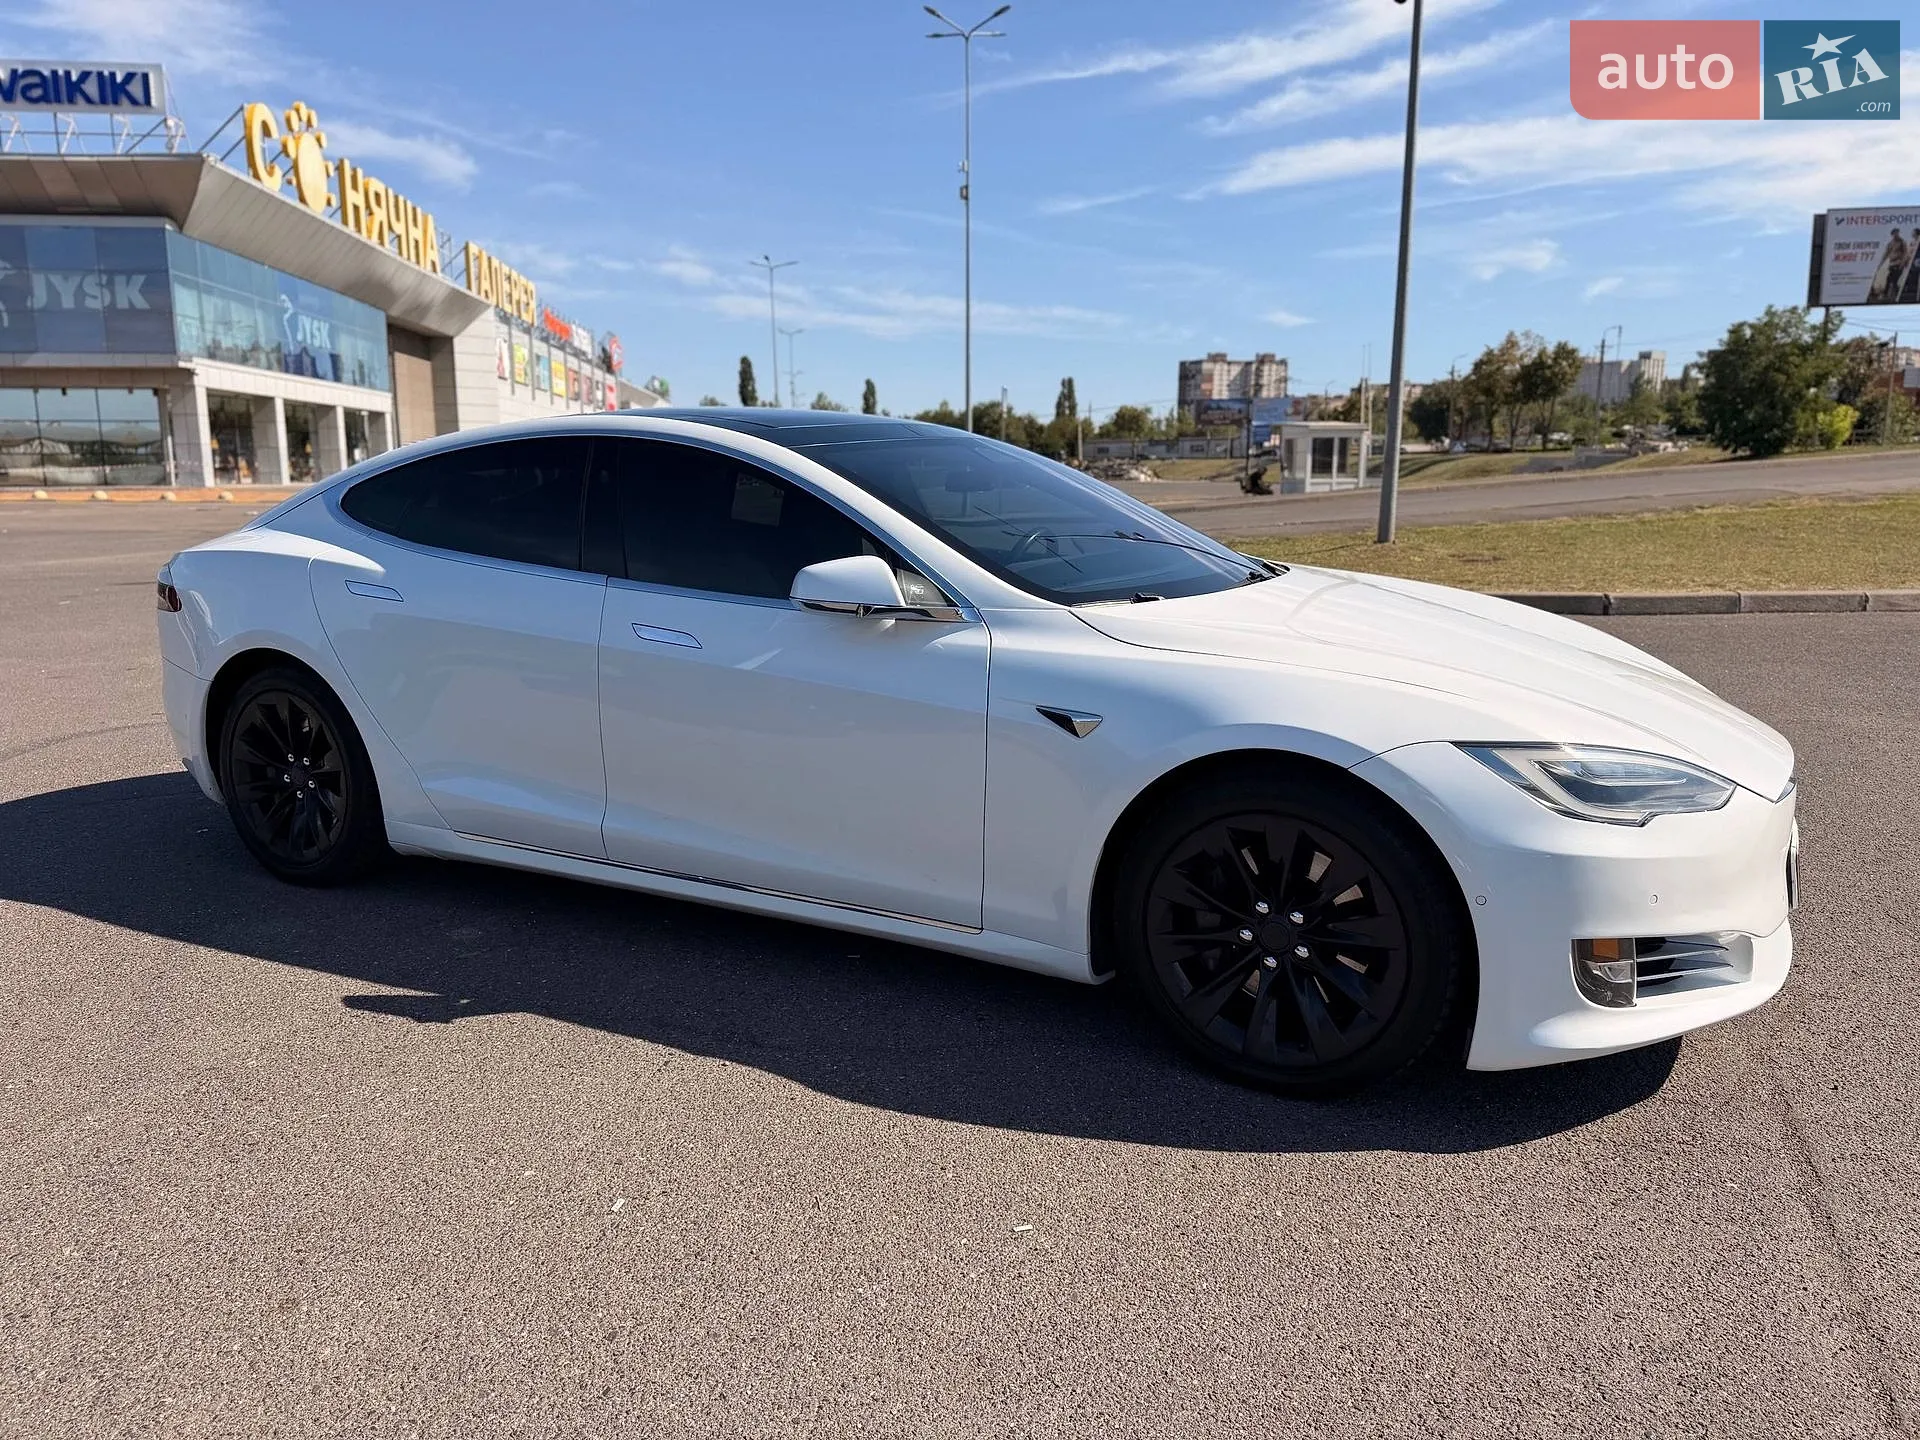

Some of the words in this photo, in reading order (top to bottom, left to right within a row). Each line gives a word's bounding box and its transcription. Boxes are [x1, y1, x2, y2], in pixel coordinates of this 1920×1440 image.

[1846, 214, 1920, 225] INTERSPORT
[28, 274, 151, 310] JYSK
[465, 241, 537, 327] ГАЛЕРЕЯ
[296, 314, 332, 349] JYSK
